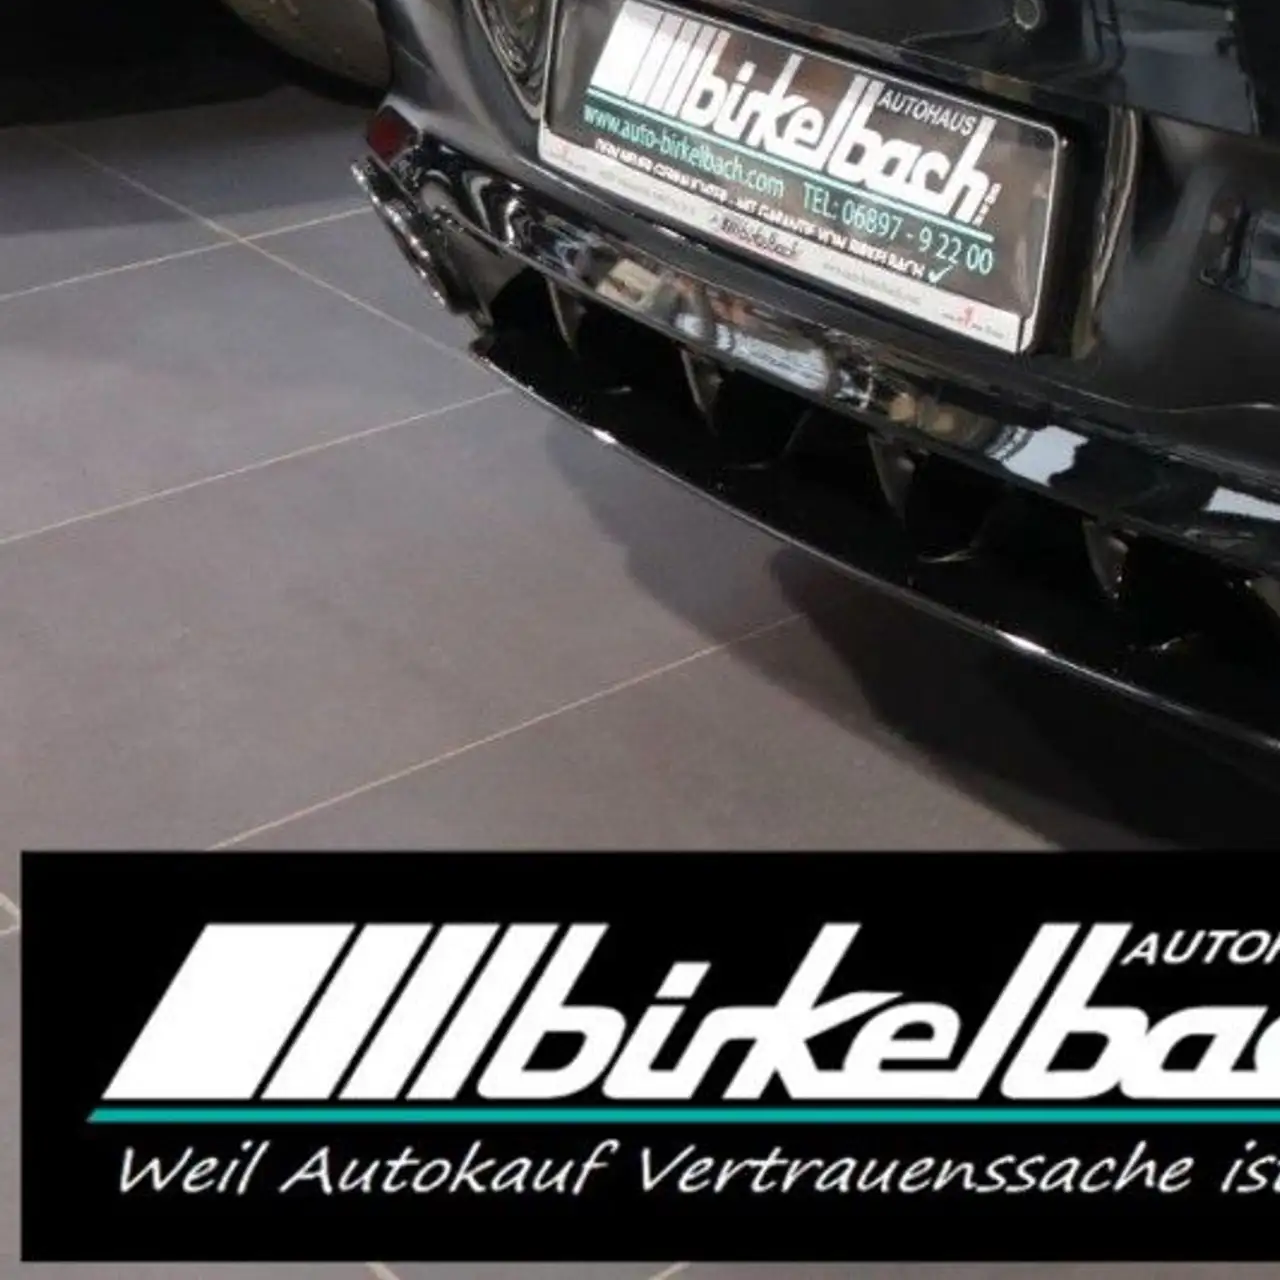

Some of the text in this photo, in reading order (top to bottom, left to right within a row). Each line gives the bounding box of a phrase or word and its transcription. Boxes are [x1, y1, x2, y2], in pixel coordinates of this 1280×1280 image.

[583, 104, 785, 199] www.auto-birkelbach.com
[841, 199, 903, 242] 06897
[679, 28, 997, 227] birkelbach
[877, 87, 978, 137] AUTOHAUS
